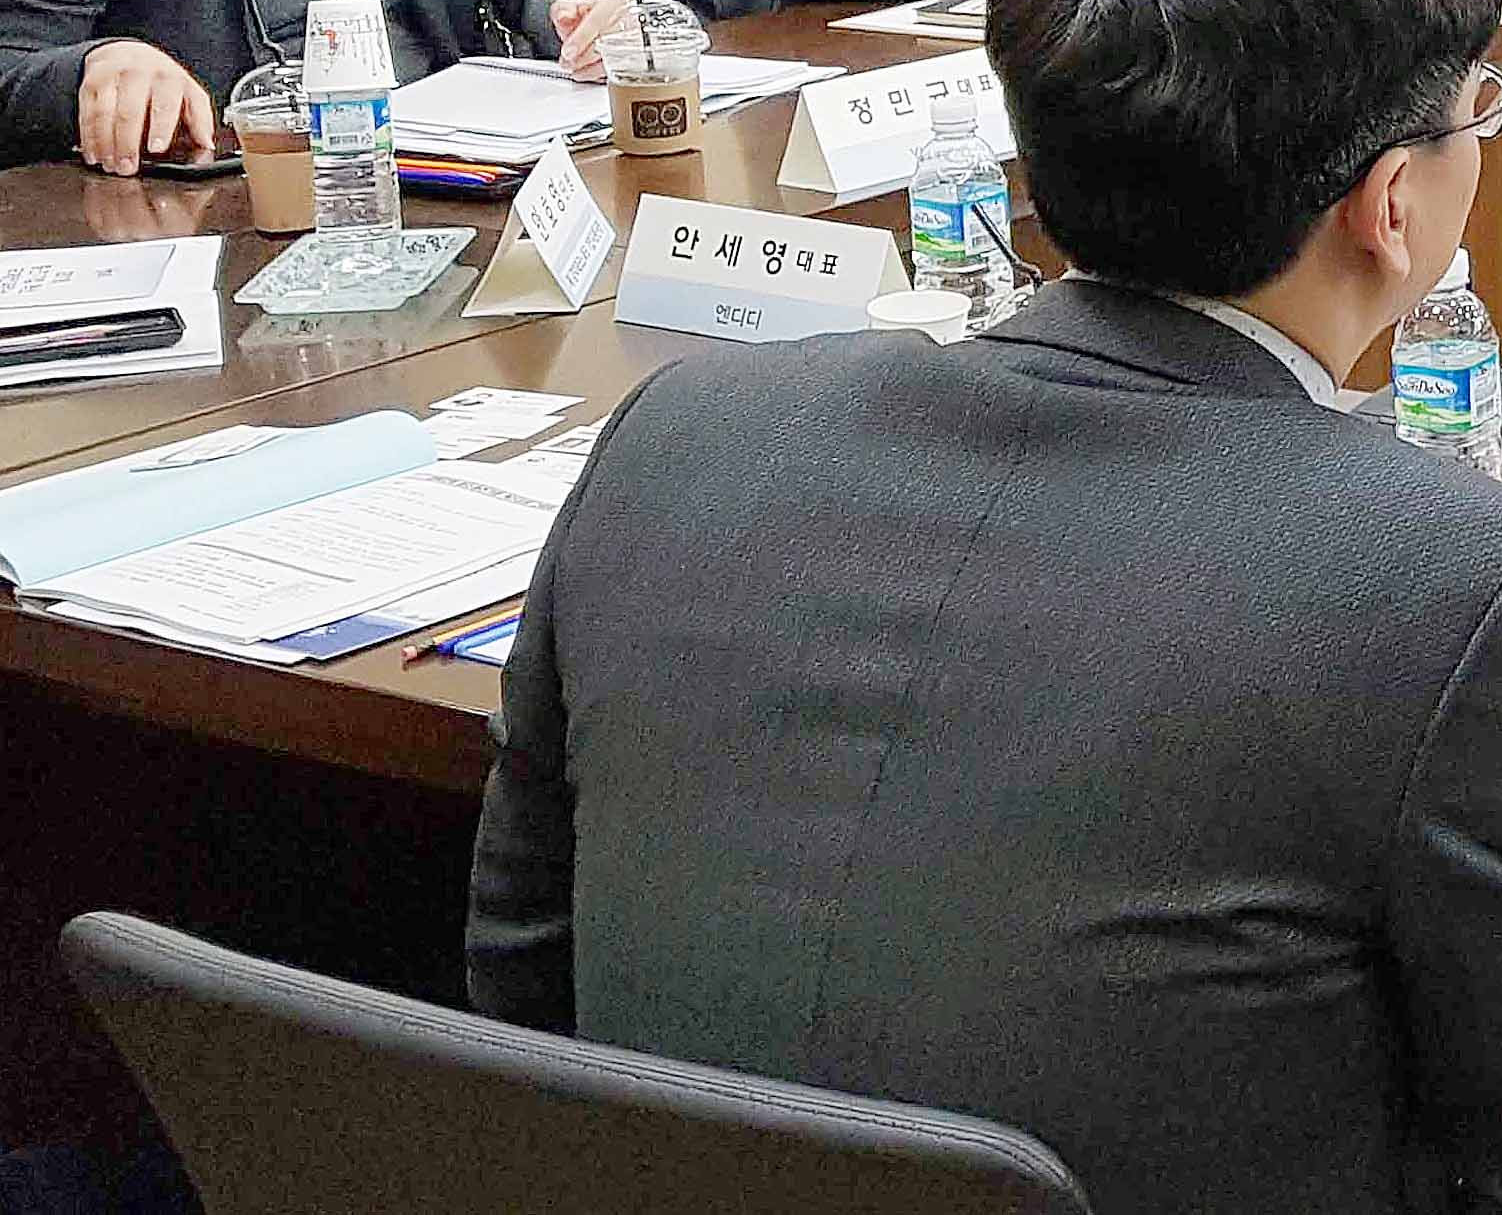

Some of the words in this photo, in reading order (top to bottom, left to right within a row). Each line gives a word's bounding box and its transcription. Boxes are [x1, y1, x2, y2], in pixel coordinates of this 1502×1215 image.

[671, 225, 788, 276] 안세영
[796, 249, 840, 276] 대표
[715, 303, 763, 331] 엔디디
